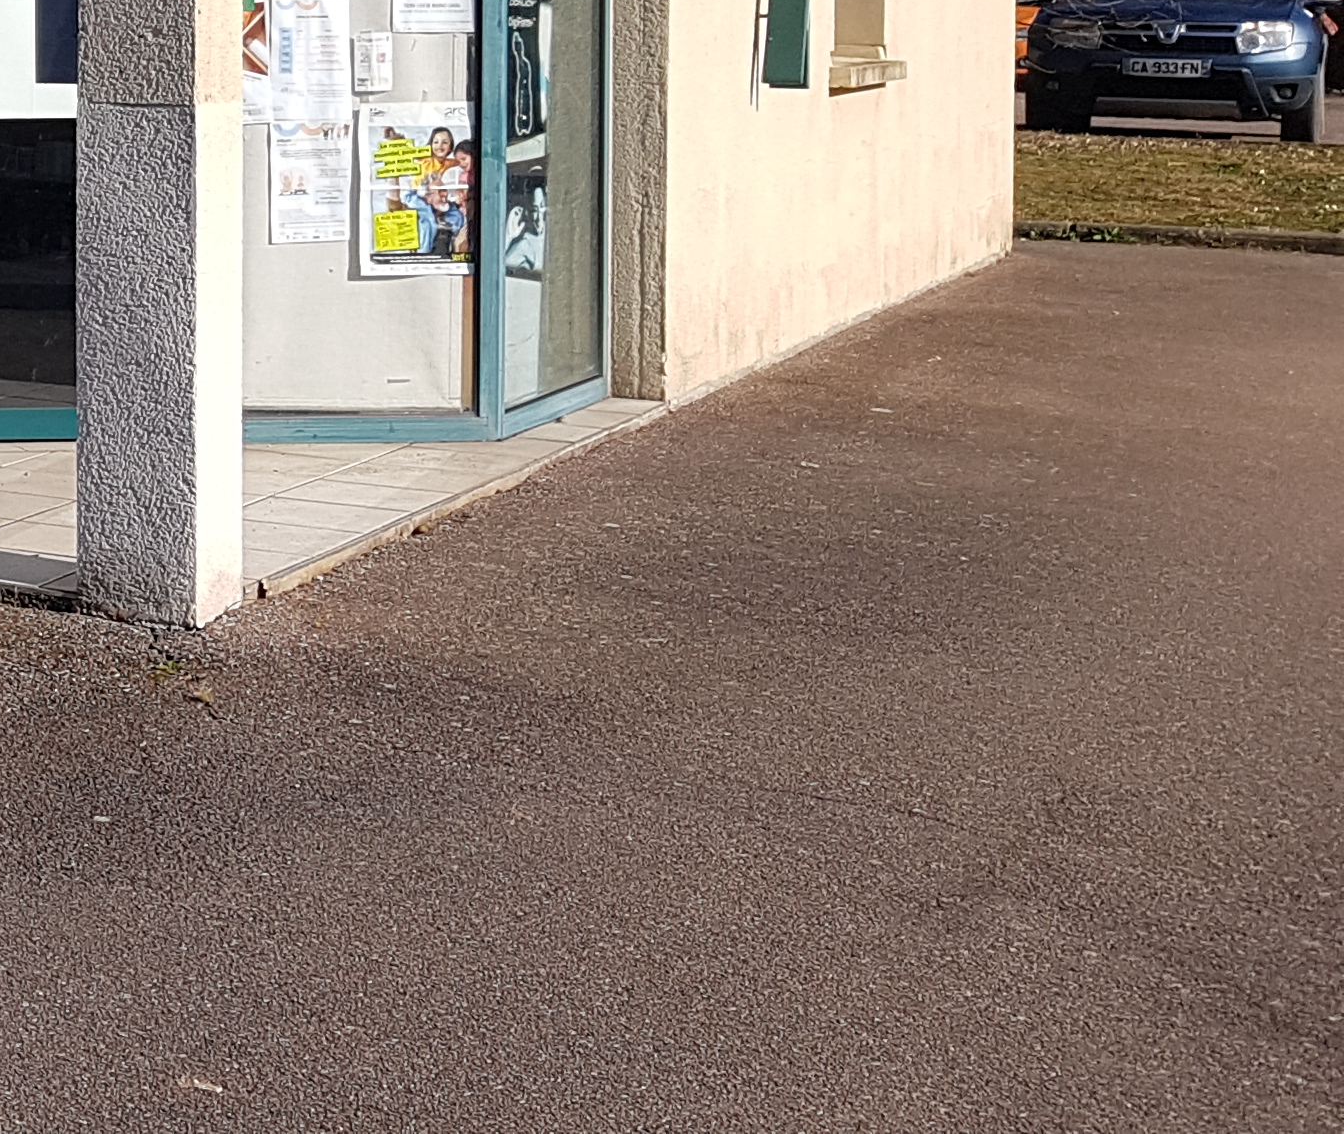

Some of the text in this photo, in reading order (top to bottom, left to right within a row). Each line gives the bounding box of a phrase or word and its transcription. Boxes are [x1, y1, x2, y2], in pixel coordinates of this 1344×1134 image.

[1131, 61, 1199, 75] CA 933 FN
